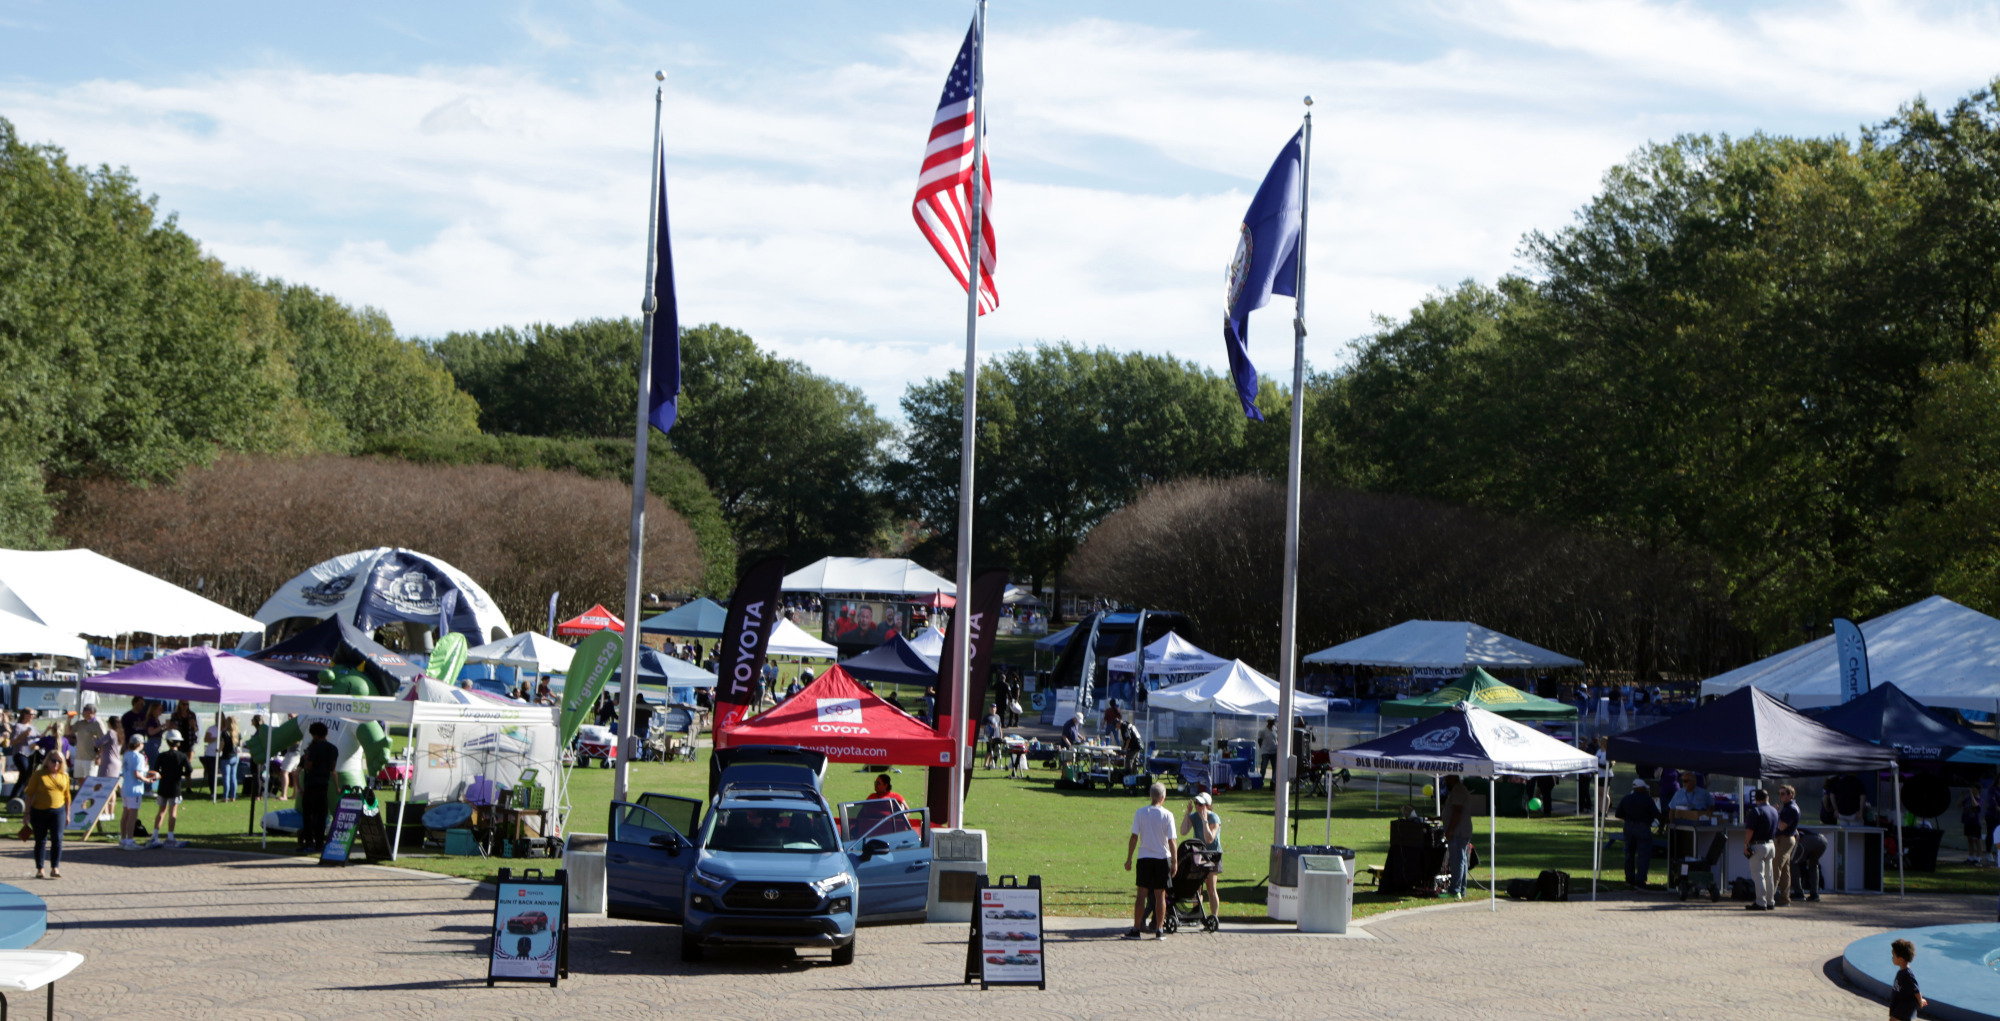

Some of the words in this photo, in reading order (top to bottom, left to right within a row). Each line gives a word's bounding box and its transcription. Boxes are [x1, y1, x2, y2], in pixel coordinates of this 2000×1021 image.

[730, 600, 765, 695] TOYOTA
[567, 640, 618, 712] Virginia529
[1166, 673, 1202, 684] WELC
[311, 697, 371, 714] Virginia529
[812, 724, 870, 734] TOYOTA
[799, 742, 888, 759] atoyota.com
[1902, 744, 1942, 757] Chartway
[1355, 757, 1371, 768] OLD
[1373, 758, 1416, 770] DOMINION
[1417, 761, 1464, 773] MONARCHS
[337, 812, 357, 822] ENTER
[332, 830, 351, 842] $529
